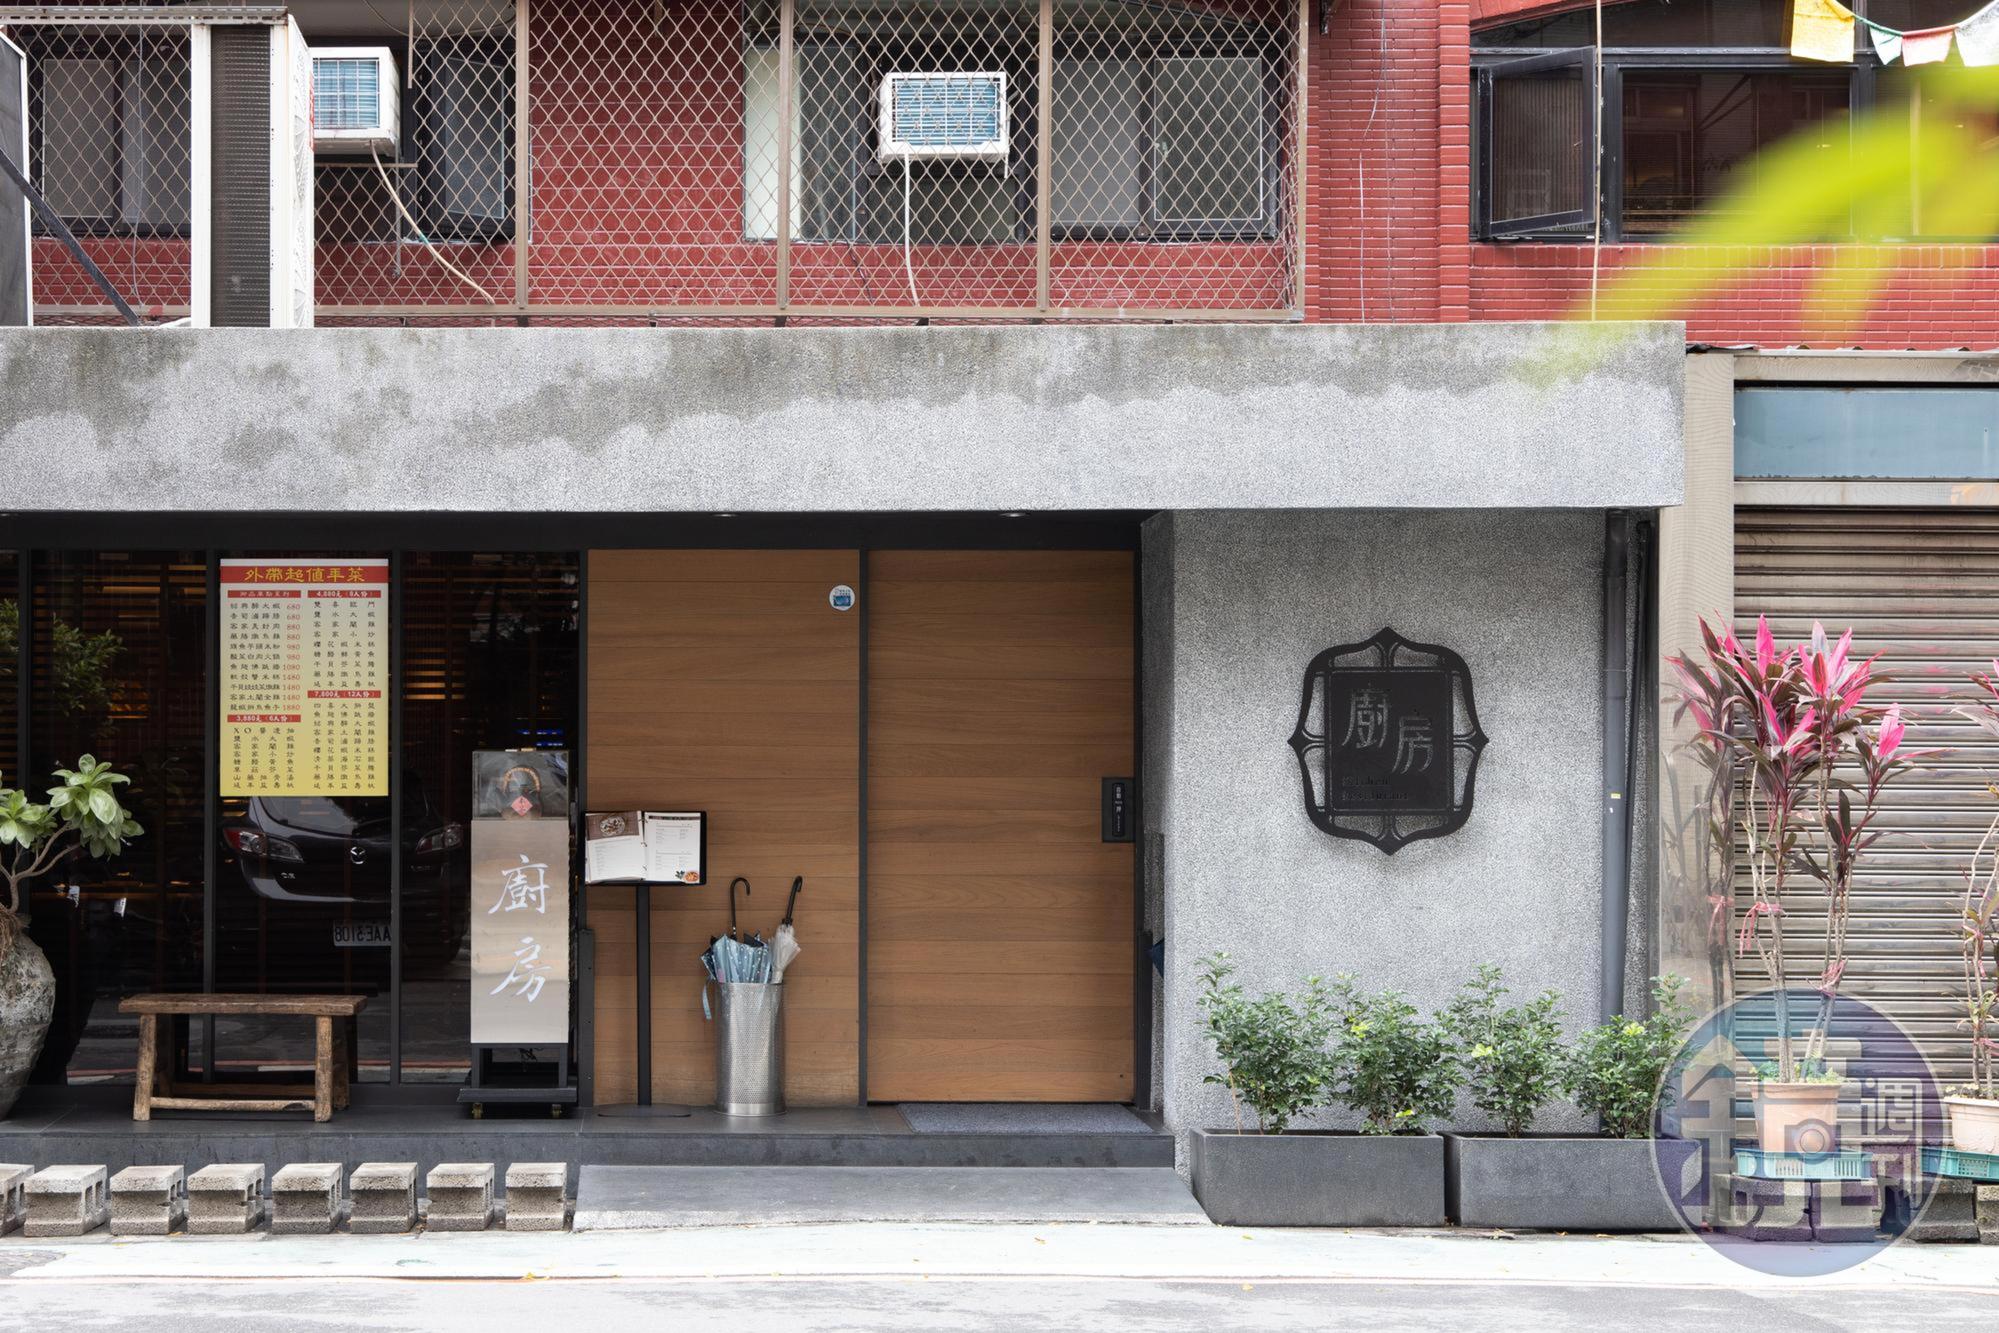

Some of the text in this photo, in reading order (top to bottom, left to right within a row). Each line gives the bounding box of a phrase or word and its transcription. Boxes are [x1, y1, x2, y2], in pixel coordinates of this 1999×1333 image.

[244, 567, 366, 583] 外帶超值年菜
[1342, 681, 1433, 774] 廚房
[488, 854, 552, 1003] 廚房
